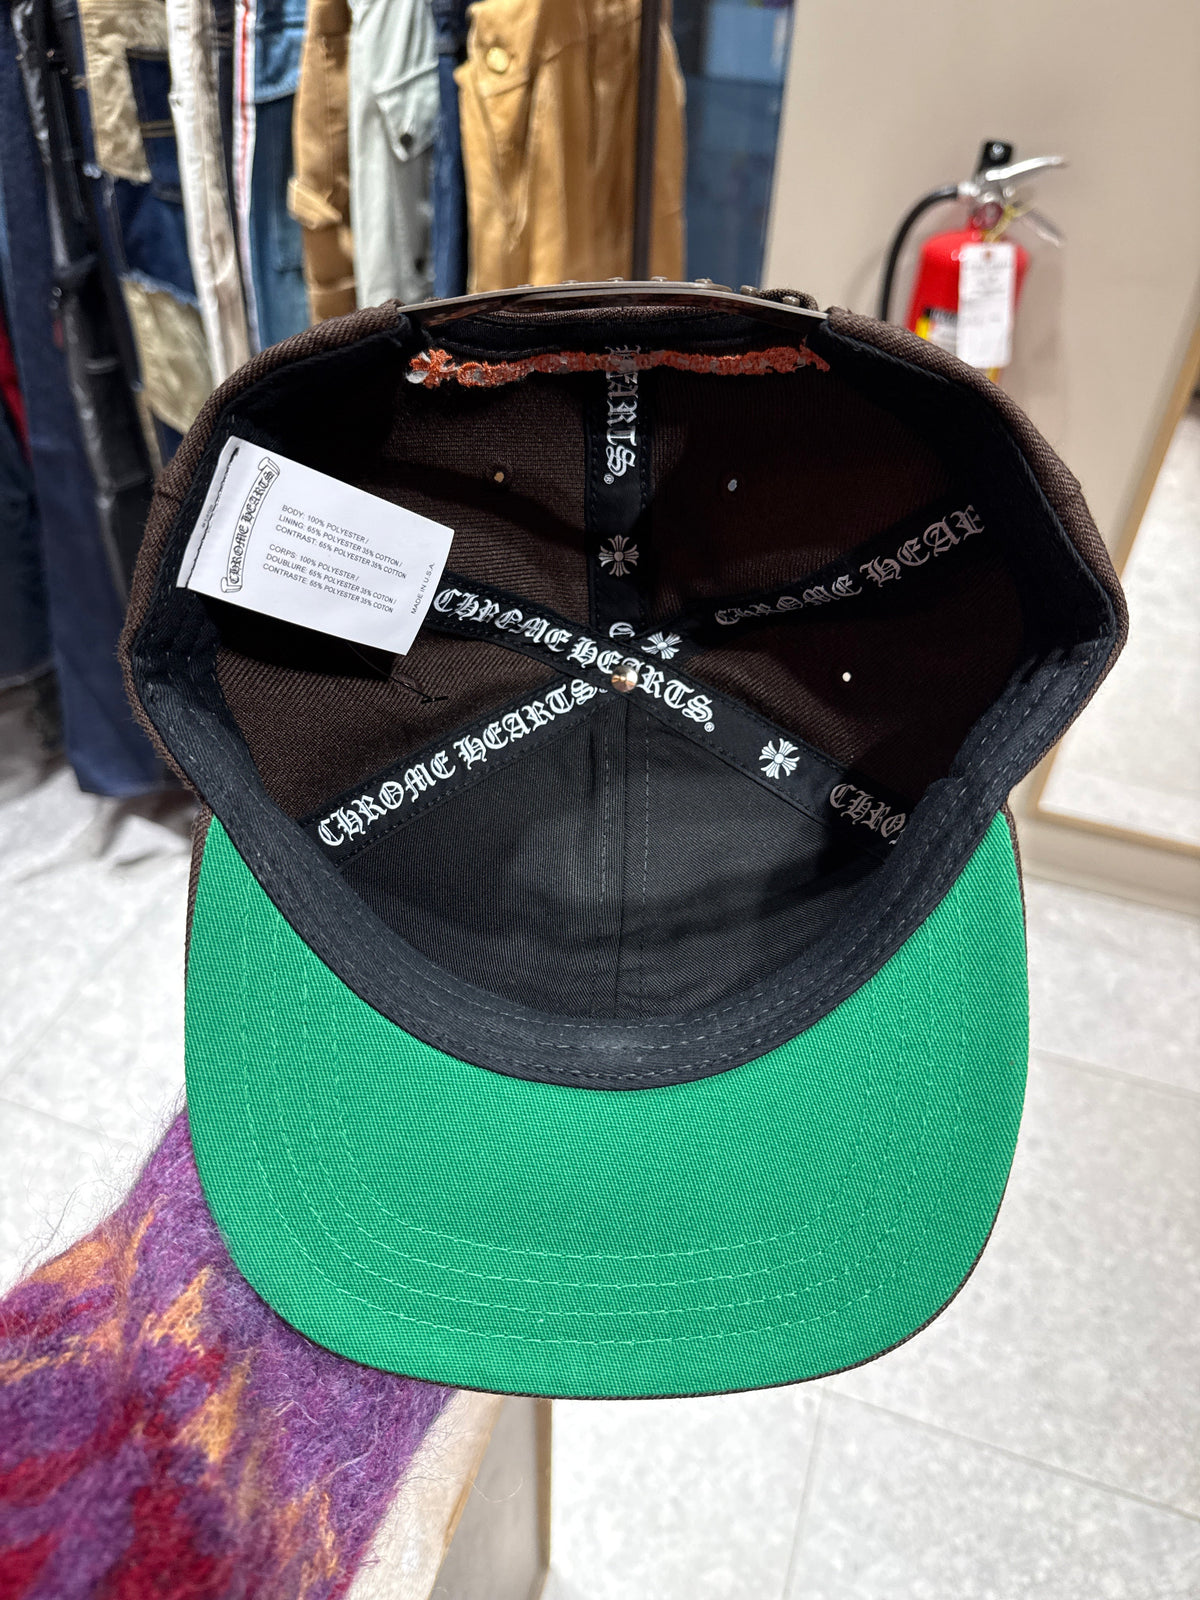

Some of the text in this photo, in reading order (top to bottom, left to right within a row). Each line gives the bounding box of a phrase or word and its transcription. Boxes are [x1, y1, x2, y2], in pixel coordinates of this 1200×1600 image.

[228, 470, 275, 585] CHROME HEARTS
[278, 514, 305, 530] LINING:
[307, 525, 322, 537] 65%
[323, 531, 362, 552] POLYESTER
[362, 547, 374, 557] 35%
[375, 552, 400, 566] COTTON
[282, 504, 305, 519] BODY:
[307, 515, 325, 527] 100%
[326, 522, 366, 543] POLYESTER
[269, 543, 298, 560] CORPS:
[299, 555, 316, 567] 100%
[317, 561, 356, 581] POLYESTER
[275, 524, 407, 579] CONTRAST: 65% POLYESTER 35% COTTON
[262, 562, 394, 614] CONTRASTE: 65% POLYESTER 35% COTON
[266, 553, 308, 574] DOUBLURE:
[308, 569, 323, 579] 65%
[323, 574, 361, 593] POLYESTER
[360, 587, 372, 597] 35%
[372, 591, 394, 604] COTON
[410, 592, 424, 615] MADE
[420, 584, 427, 593] IN
[433, 588, 573, 653] CHROME
[317, 750, 457, 848] CHROME
[829, 783, 907, 845] CHRO
